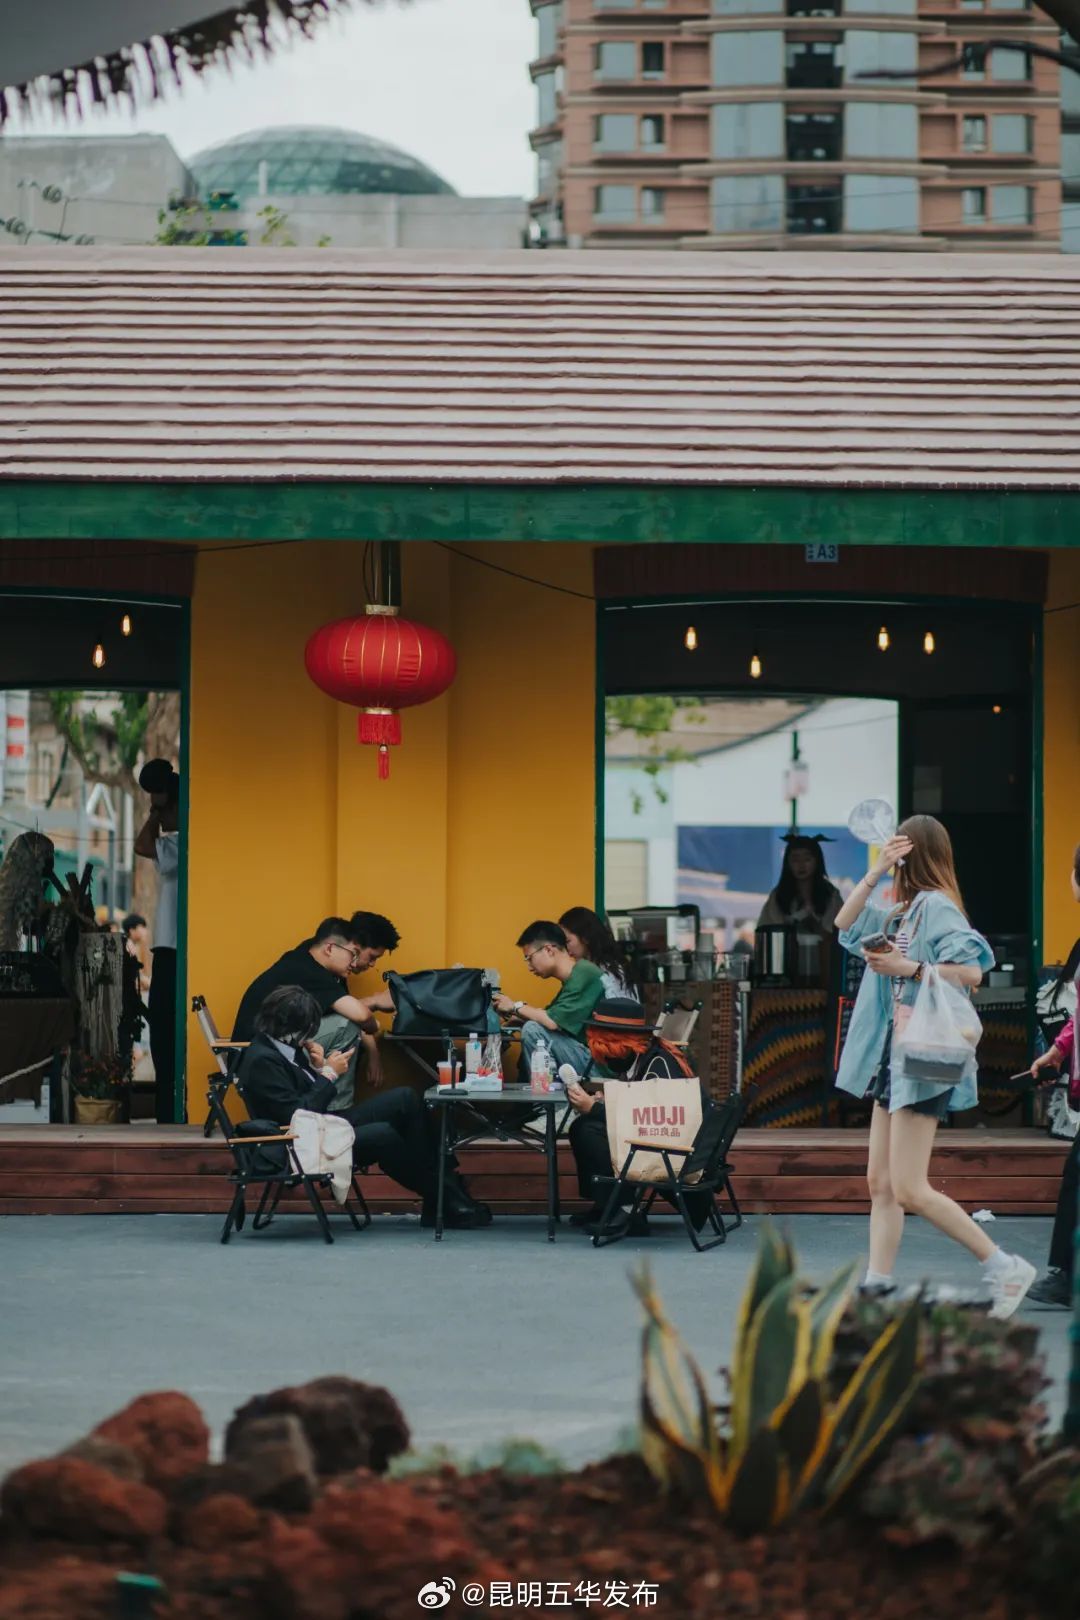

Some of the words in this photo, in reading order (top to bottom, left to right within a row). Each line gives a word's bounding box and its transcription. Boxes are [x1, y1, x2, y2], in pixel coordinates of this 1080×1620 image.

[817, 543, 836, 560] A3
[632, 1105, 686, 1126] MUJI
[638, 1127, 681, 1137] 無印良品
